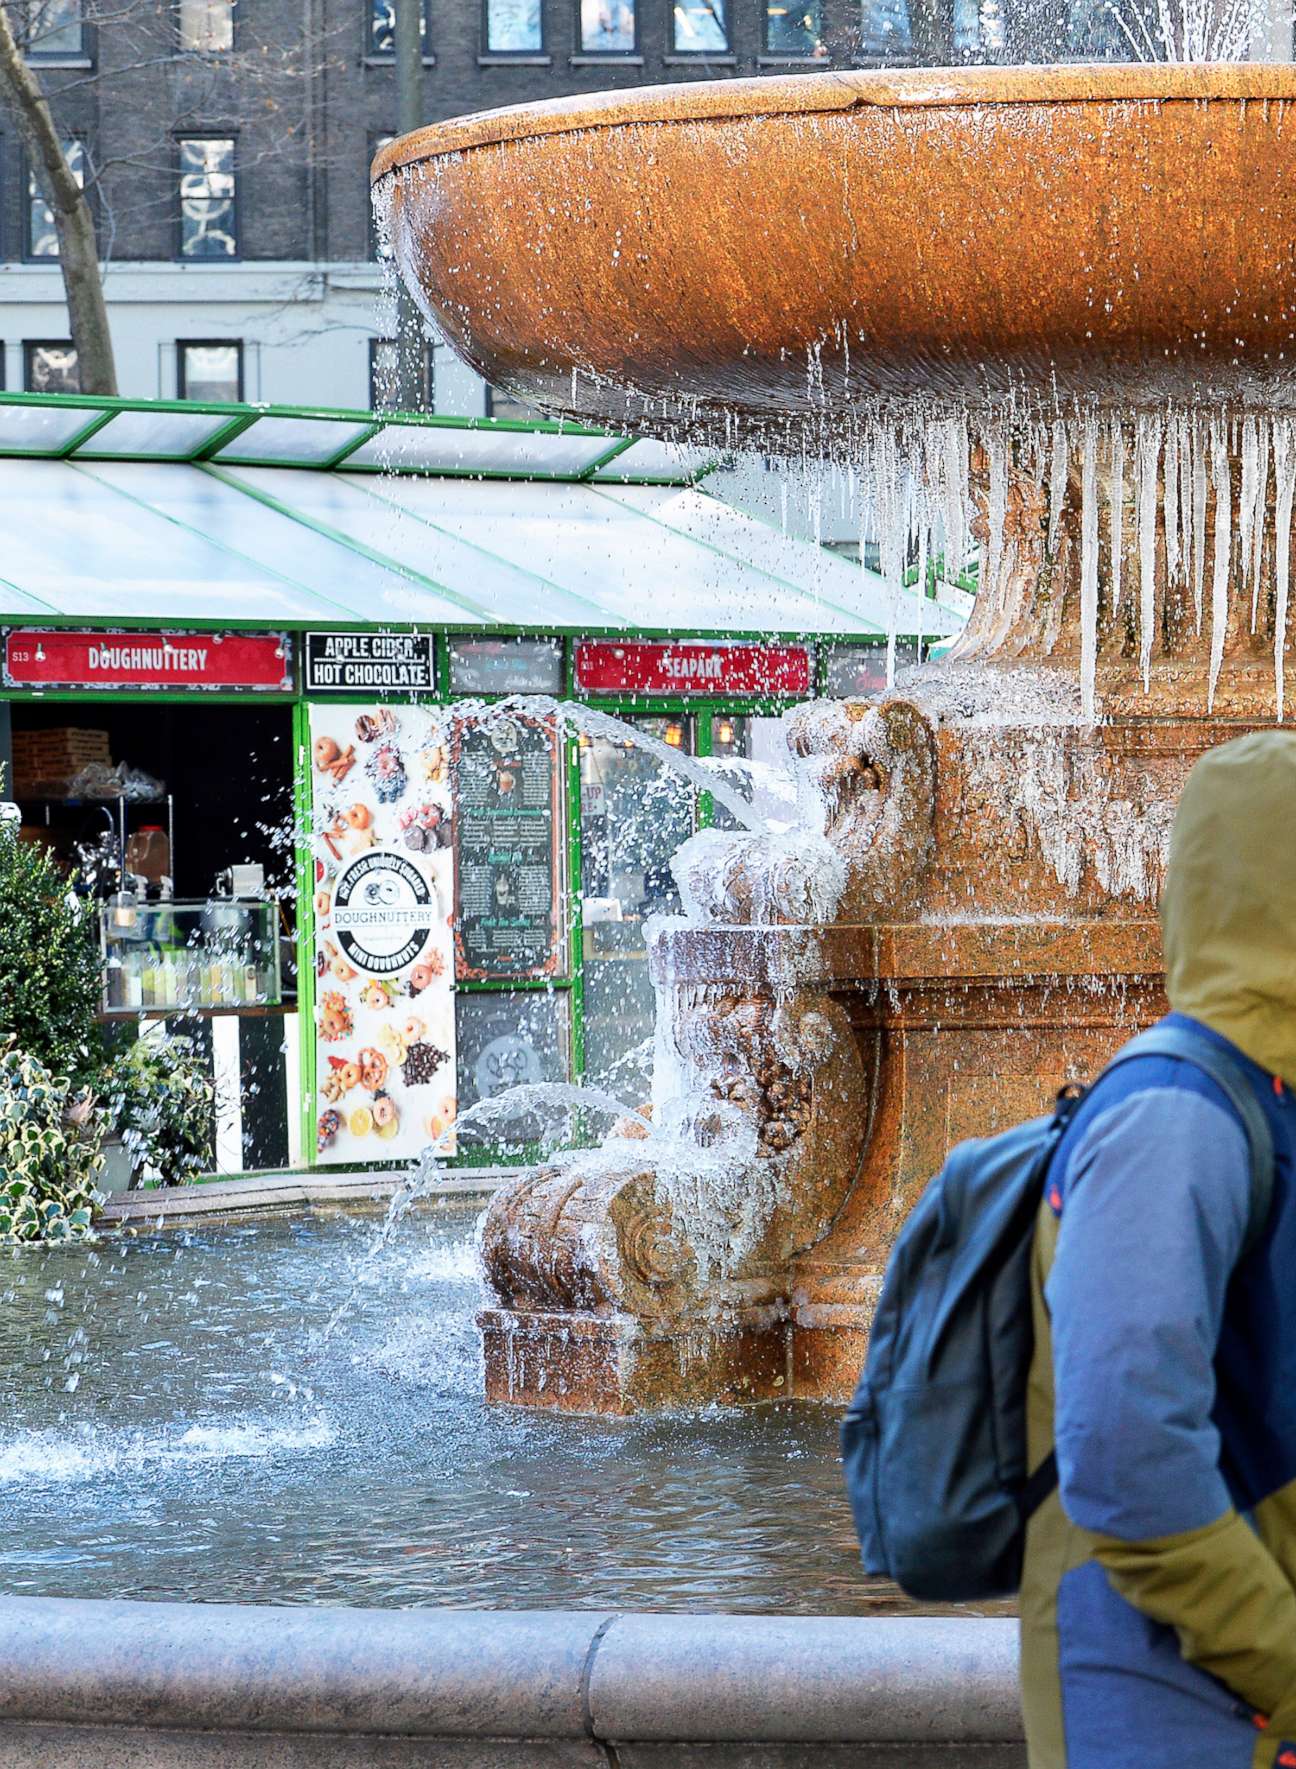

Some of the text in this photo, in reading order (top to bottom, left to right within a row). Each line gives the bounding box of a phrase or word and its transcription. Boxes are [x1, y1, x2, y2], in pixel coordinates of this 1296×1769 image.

[12, 651, 30, 662] S13
[325, 637, 414, 658] APPLE CIDER
[88, 647, 208, 671] DOUGHNUTTERY
[665, 657, 724, 679] SEAPARK
[313, 663, 427, 685] HOT CHOCOLATE
[334, 911, 432, 924] DOUGHNUTTERY
